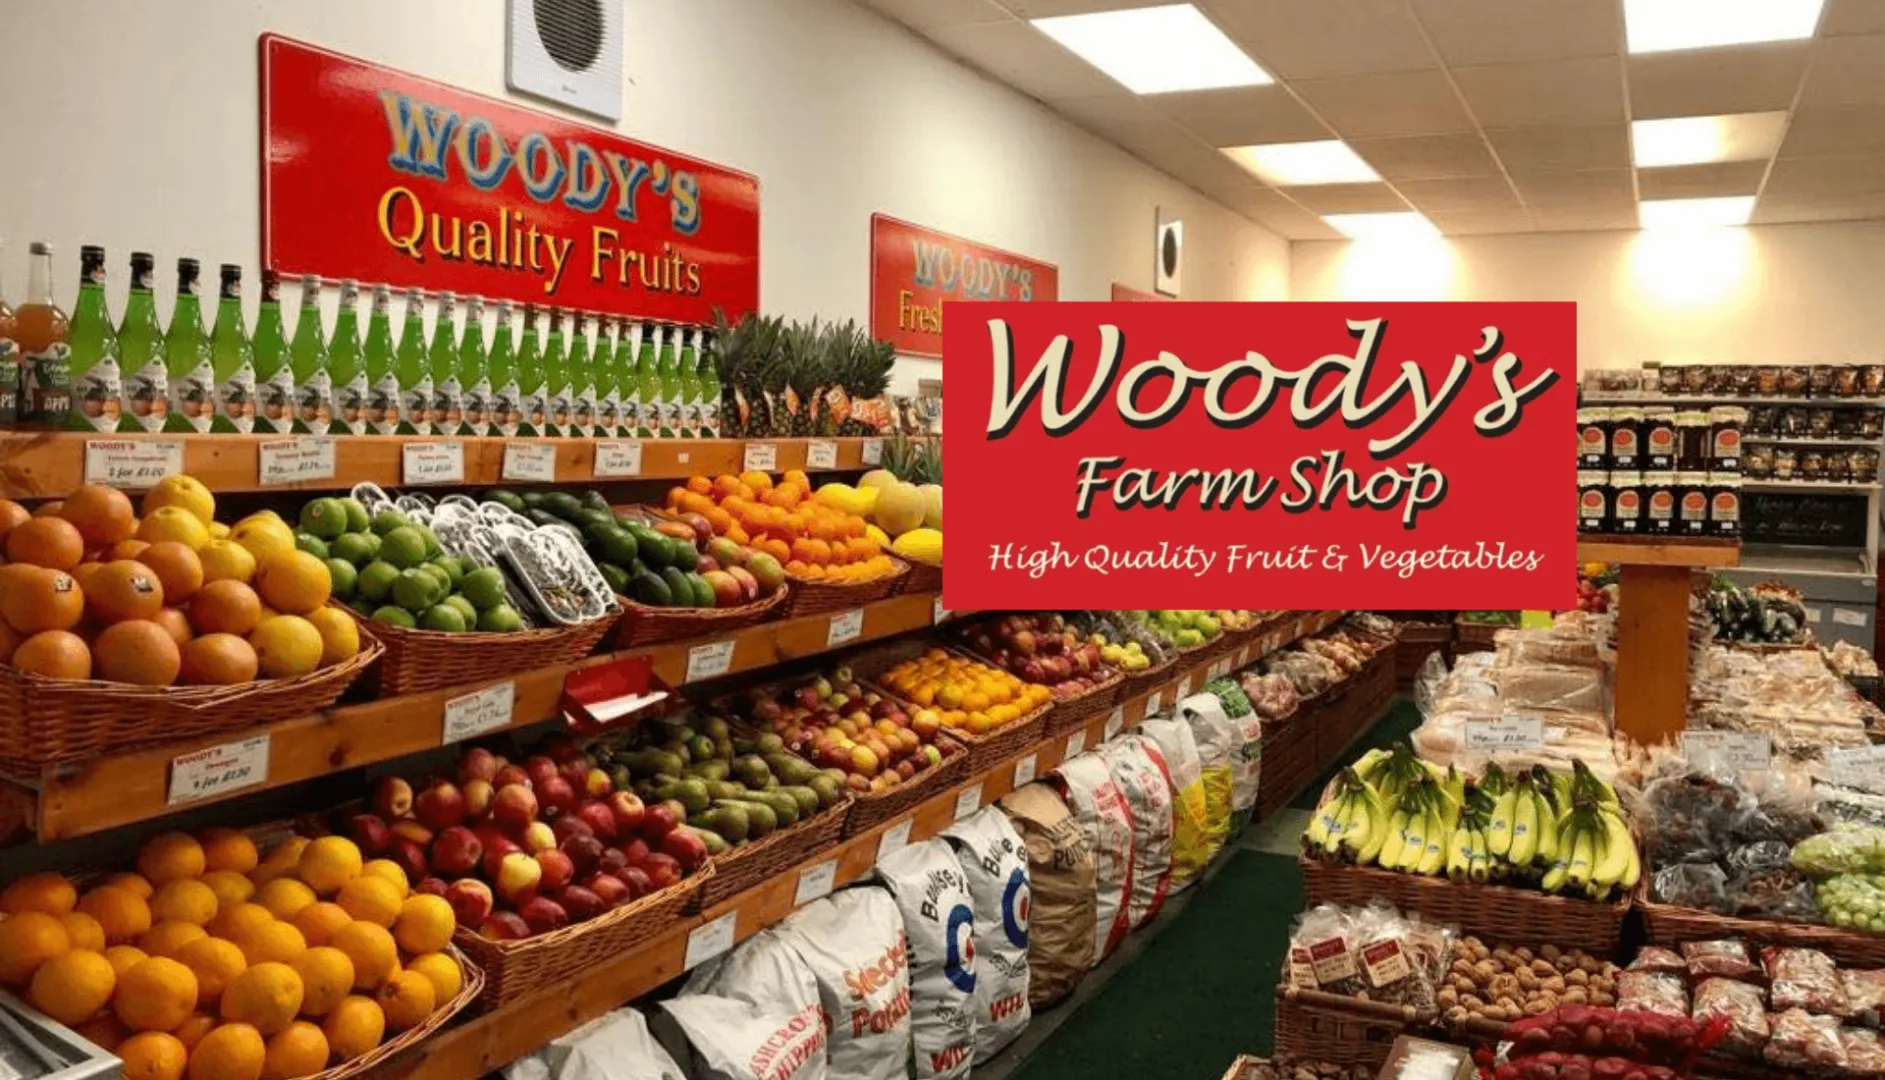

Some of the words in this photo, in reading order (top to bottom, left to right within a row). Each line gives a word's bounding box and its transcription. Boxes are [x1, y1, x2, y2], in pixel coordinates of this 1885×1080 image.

[379, 88, 701, 237] WOODY'S
[378, 186, 573, 294] Quality
[591, 225, 701, 294] Fruits
[914, 238, 1033, 301] WOODY'S
